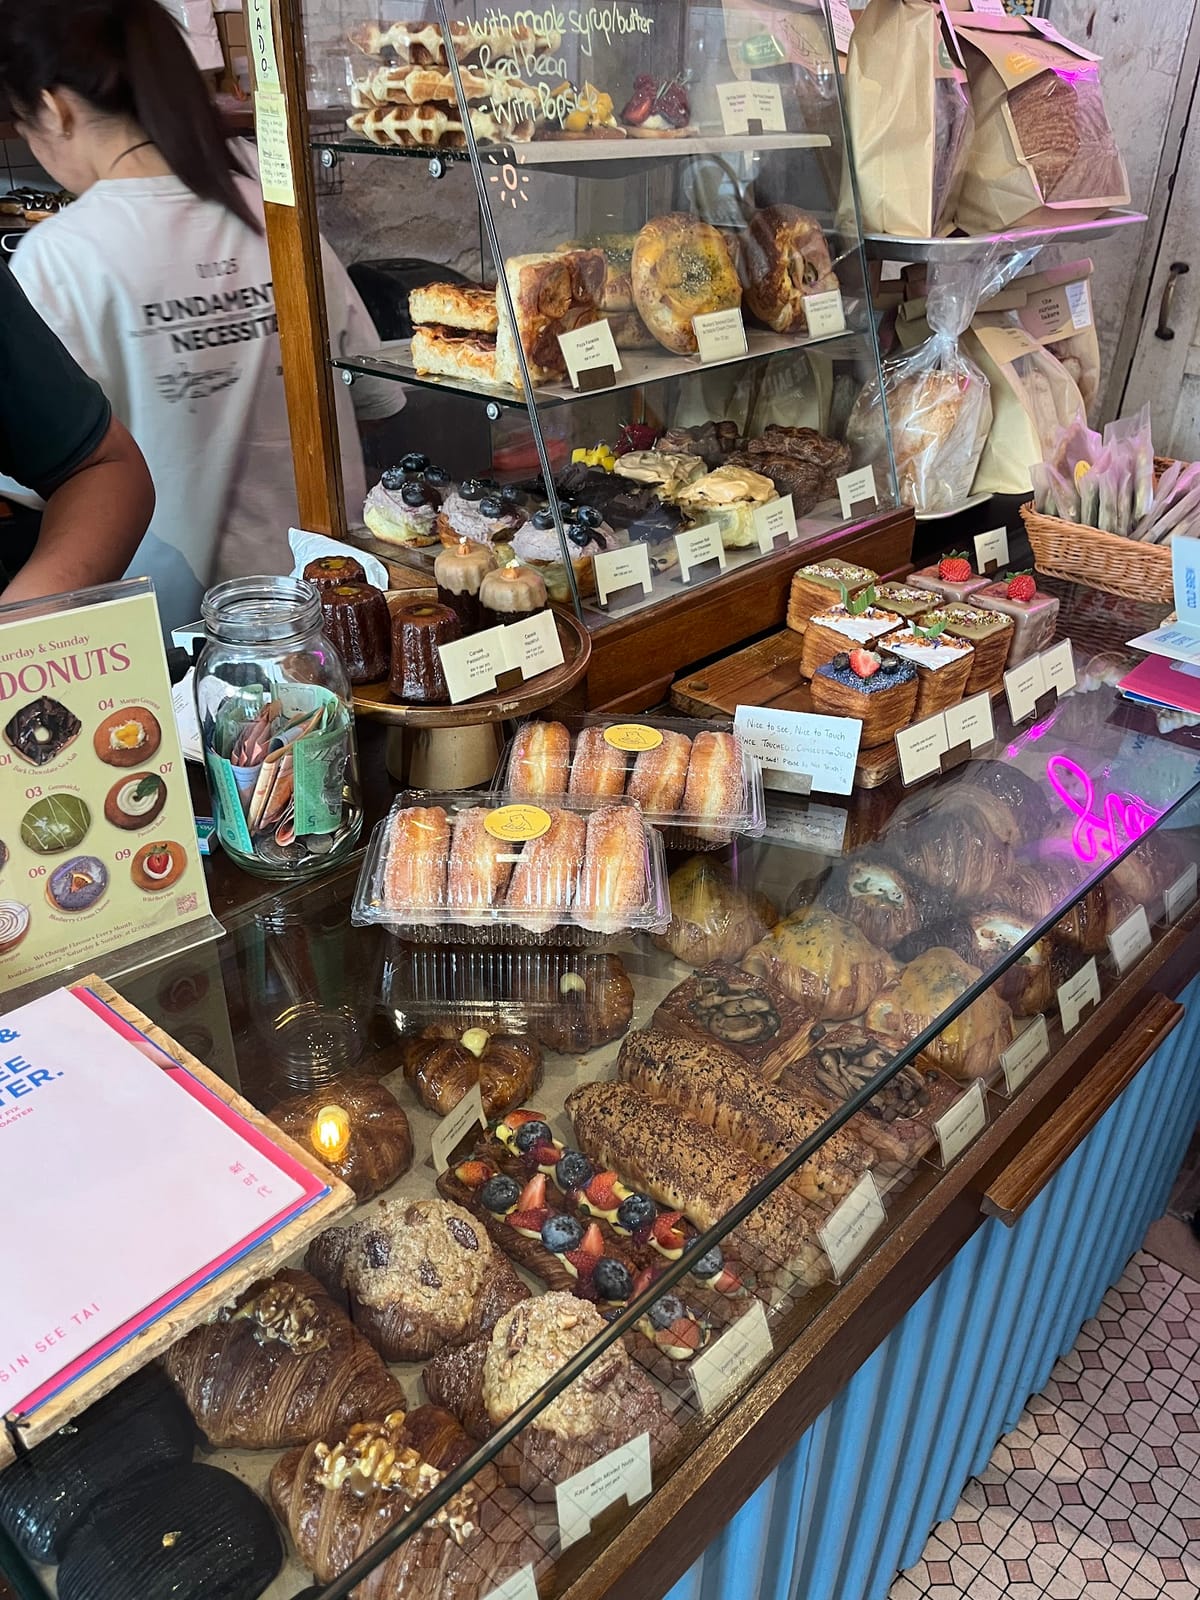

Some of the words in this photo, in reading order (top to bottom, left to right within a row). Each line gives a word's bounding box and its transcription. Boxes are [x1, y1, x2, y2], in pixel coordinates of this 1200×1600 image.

[513, 5, 567, 49] maple
[519, 43, 568, 79] bean
[0, 647, 36, 662] urday
[38, 643, 47, 654] &
[48, 634, 90, 652] Sunday
[0, 642, 131, 701] DONUTS
[98, 697, 115, 711] 04
[746, 718, 763, 730] Nice
[767, 722, 775, 732] to
[794, 725, 811, 737] Nice
[813, 728, 822, 737] to
[824, 728, 846, 741] Touch
[159, 761, 174, 775] 07
[25, 785, 43, 799] 03
[114, 848, 132, 862] 09
[28, 865, 47, 879] 06
[33, 954, 45, 962] We
[44, 945, 68, 959] Change
[0, 1028, 22, 1044] &
[0, 1353, 30, 1382] SIN
[34, 1325, 67, 1353] SEE
[70, 1301, 101, 1325] TAI
[621, 1456, 635, 1469] Nuts
